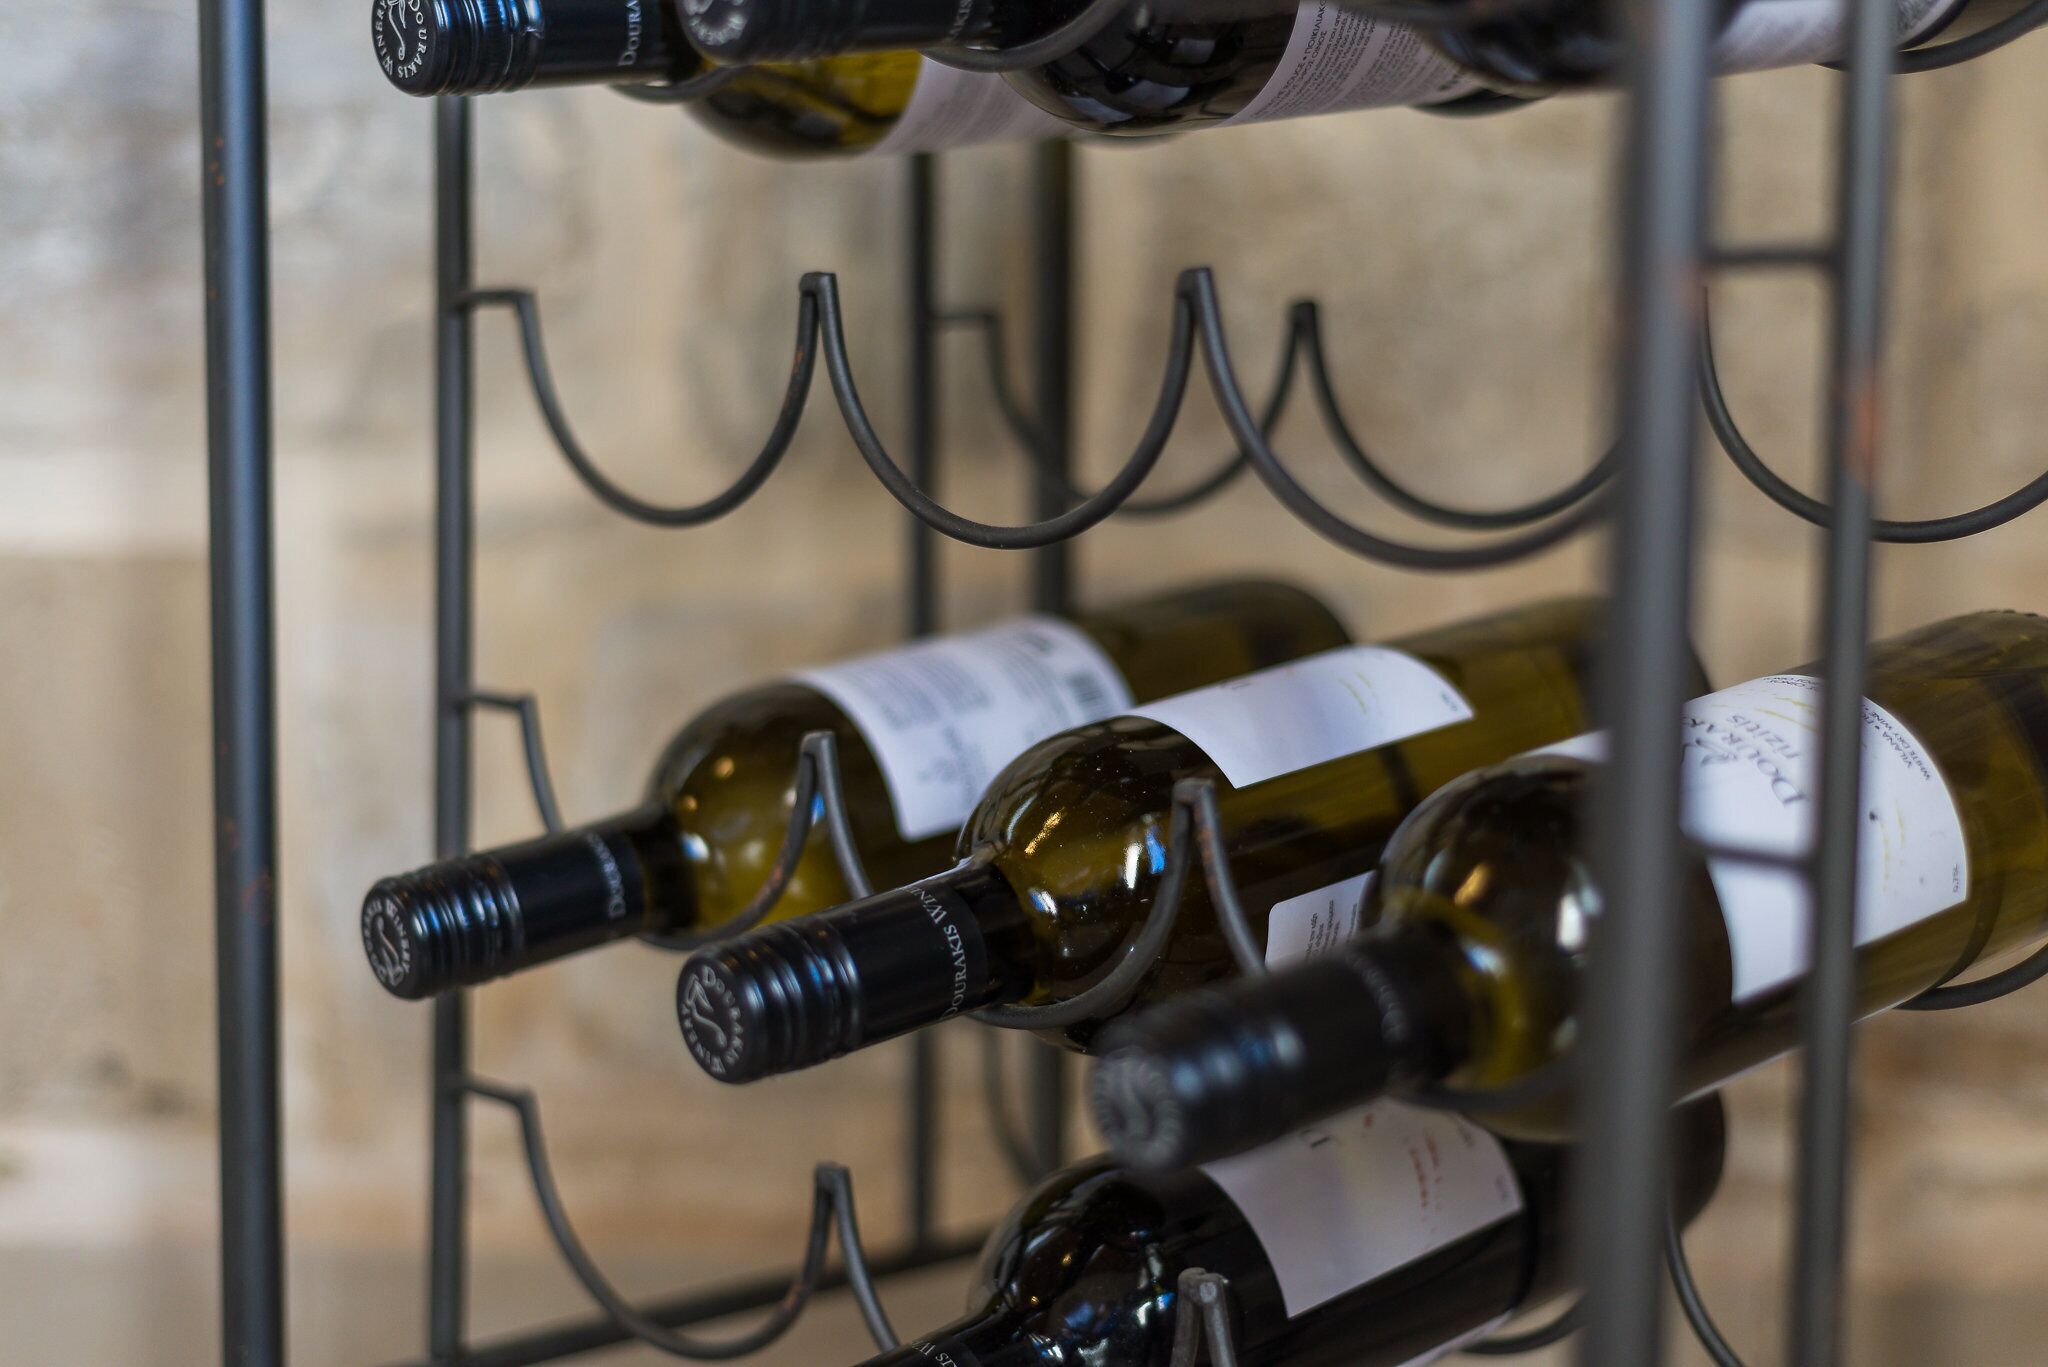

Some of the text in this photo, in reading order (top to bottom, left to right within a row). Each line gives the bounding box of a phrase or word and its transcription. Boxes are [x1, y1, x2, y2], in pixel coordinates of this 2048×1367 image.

[397, 0, 428, 79] DOURAKIS
[1871, 711, 1893, 731] WINE
[1882, 731, 1913, 770] VILANA
[1909, 750, 1931, 781] WHITE
[940, 924, 967, 1020] DOURAKIS
